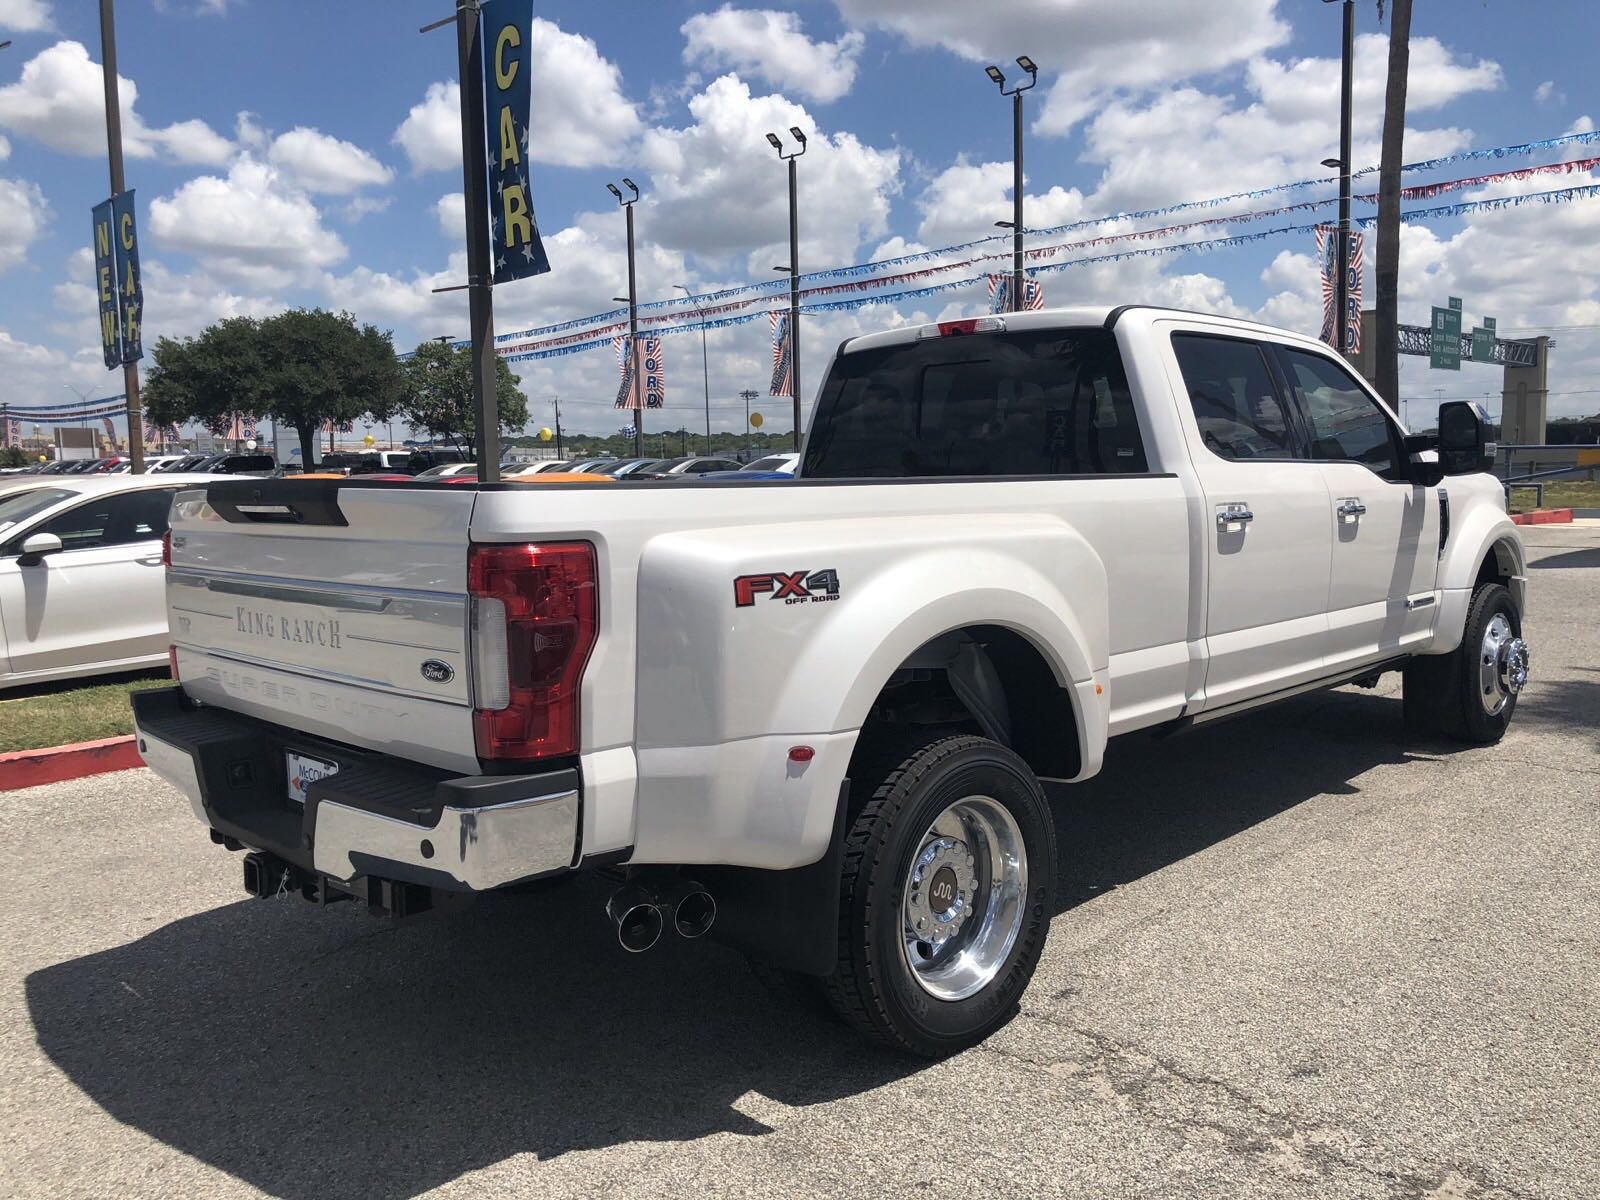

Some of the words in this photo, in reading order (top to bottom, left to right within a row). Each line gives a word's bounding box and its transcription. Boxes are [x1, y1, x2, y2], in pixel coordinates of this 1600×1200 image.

[495, 25, 532, 248] CAR
[97, 221, 116, 346] NEW
[1347, 235, 1358, 349] FORD
[645, 341, 658, 408] FORD
[733, 568, 841, 608] FX4
[785, 597, 808, 605] OFF
[811, 594, 840, 603] ROAD
[236, 606, 275, 638] KING
[281, 616, 342, 649] RANCH
[206, 666, 302, 704] SUPER
[425, 664, 444, 679] Ford
